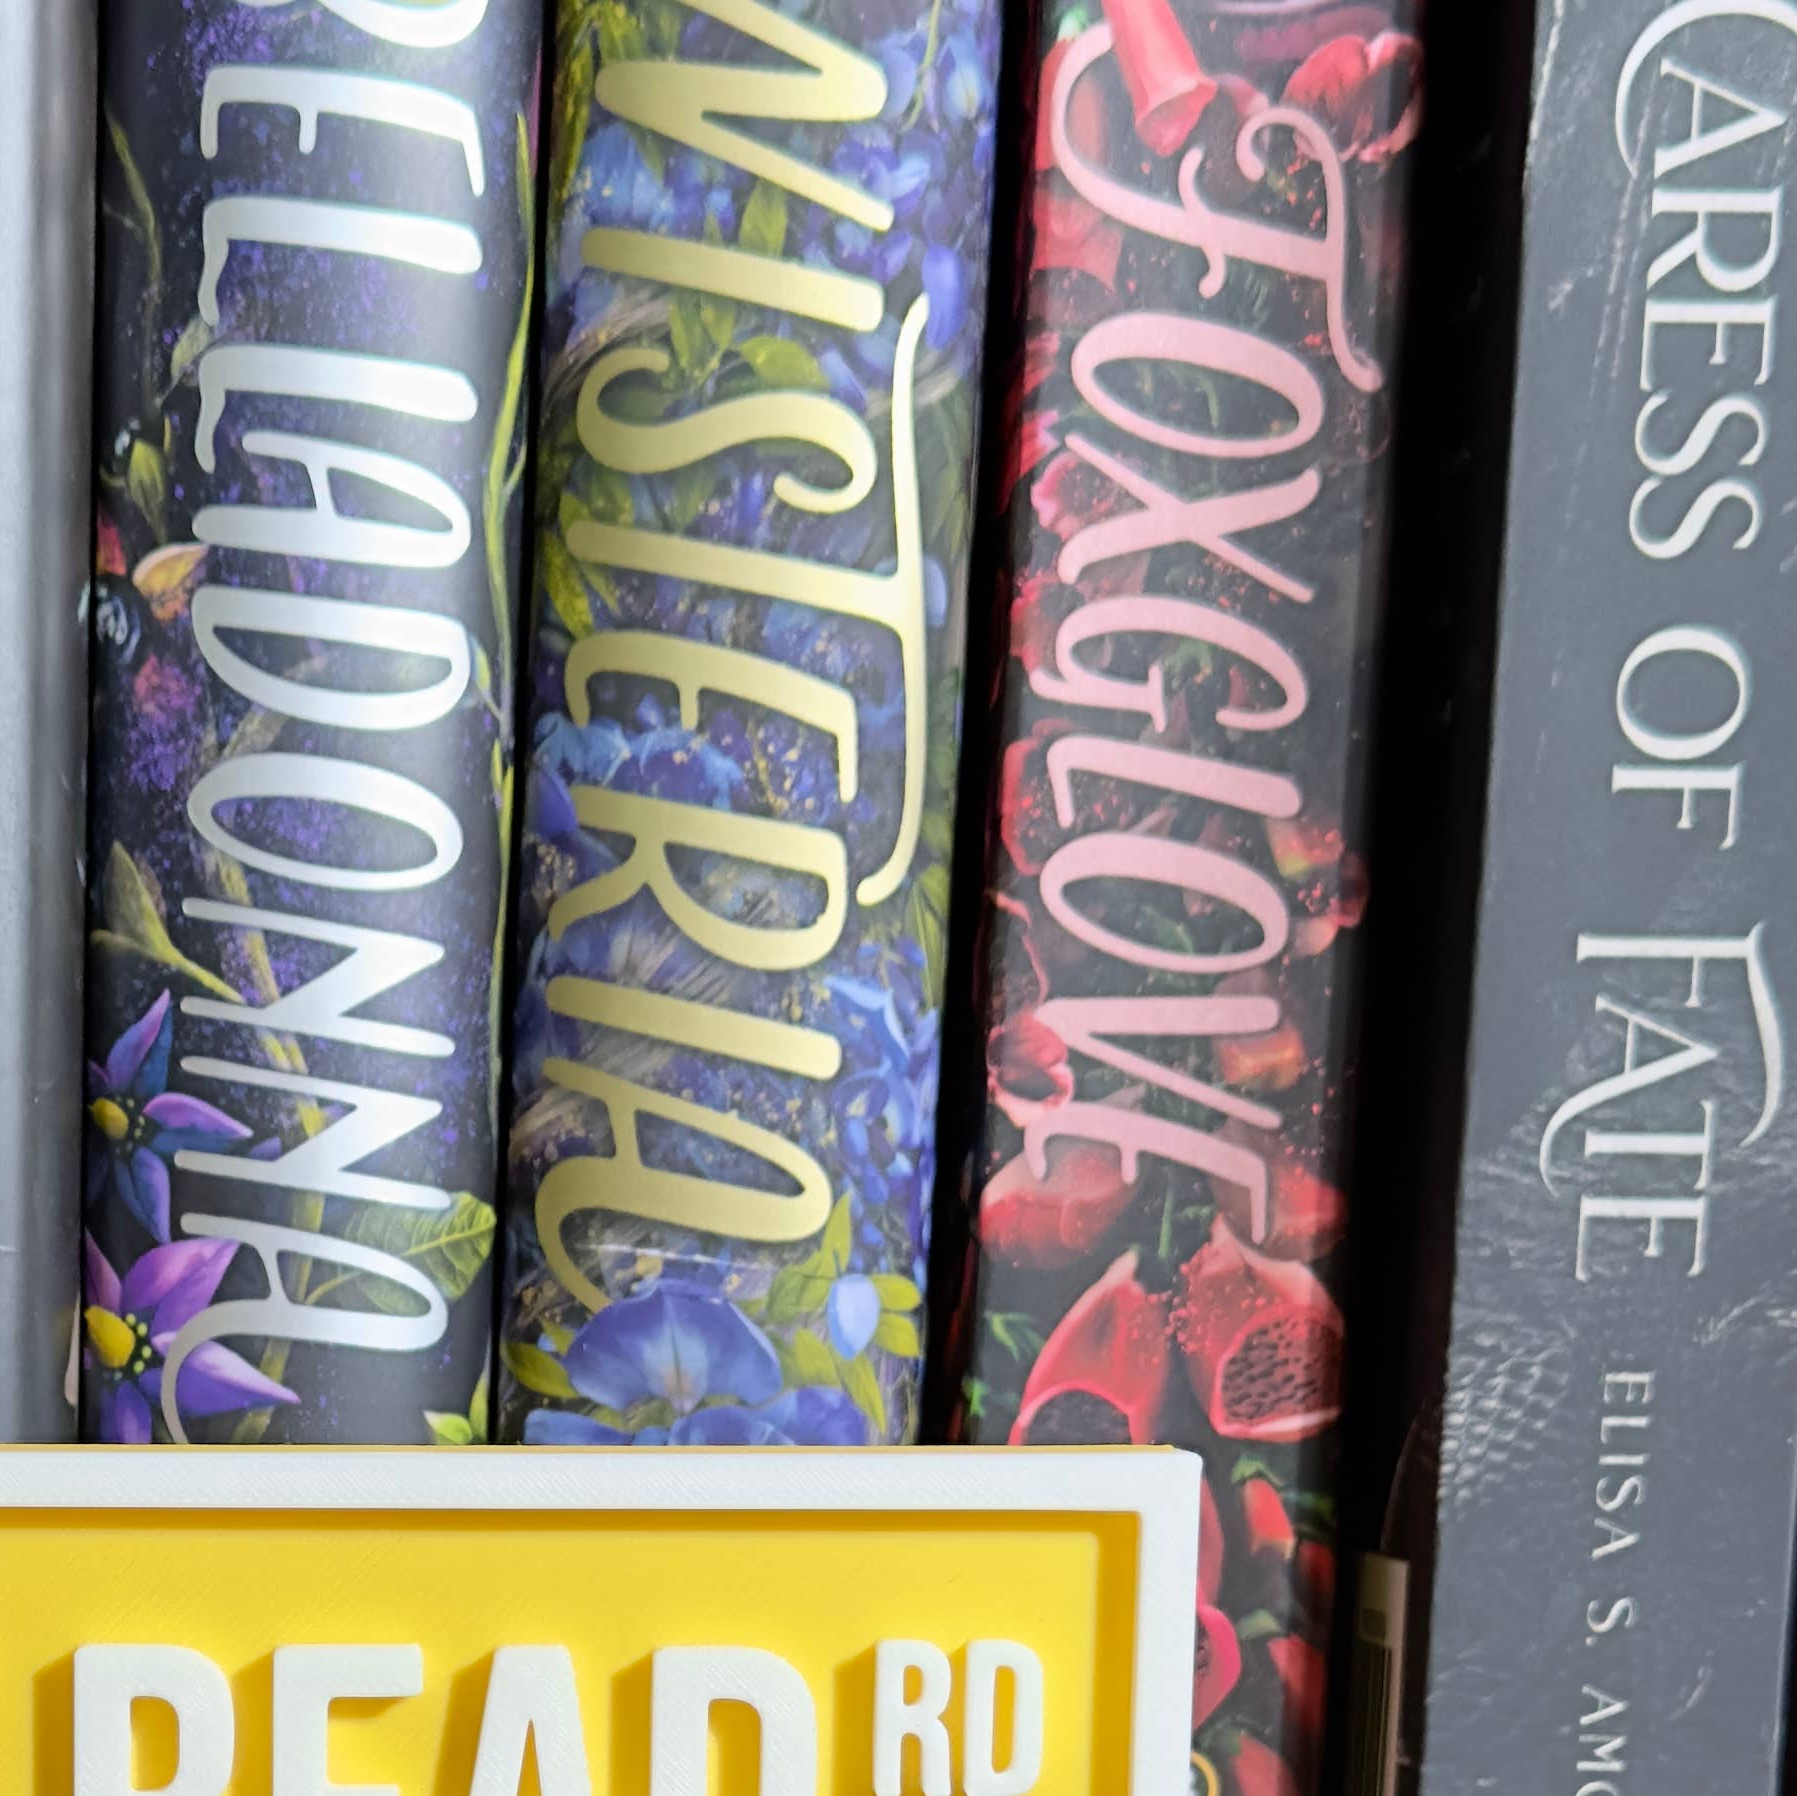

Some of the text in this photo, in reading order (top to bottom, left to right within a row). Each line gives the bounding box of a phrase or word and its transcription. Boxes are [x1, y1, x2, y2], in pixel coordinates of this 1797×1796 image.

[1022, 22, 1384, 1246] FOXGLOVE
[1611, 622, 1752, 850] OF
[1540, 920, 1786, 1281] FATE
[1591, 1368, 1656, 1561] ELISA
[1584, 1596, 1637, 1647] S.
